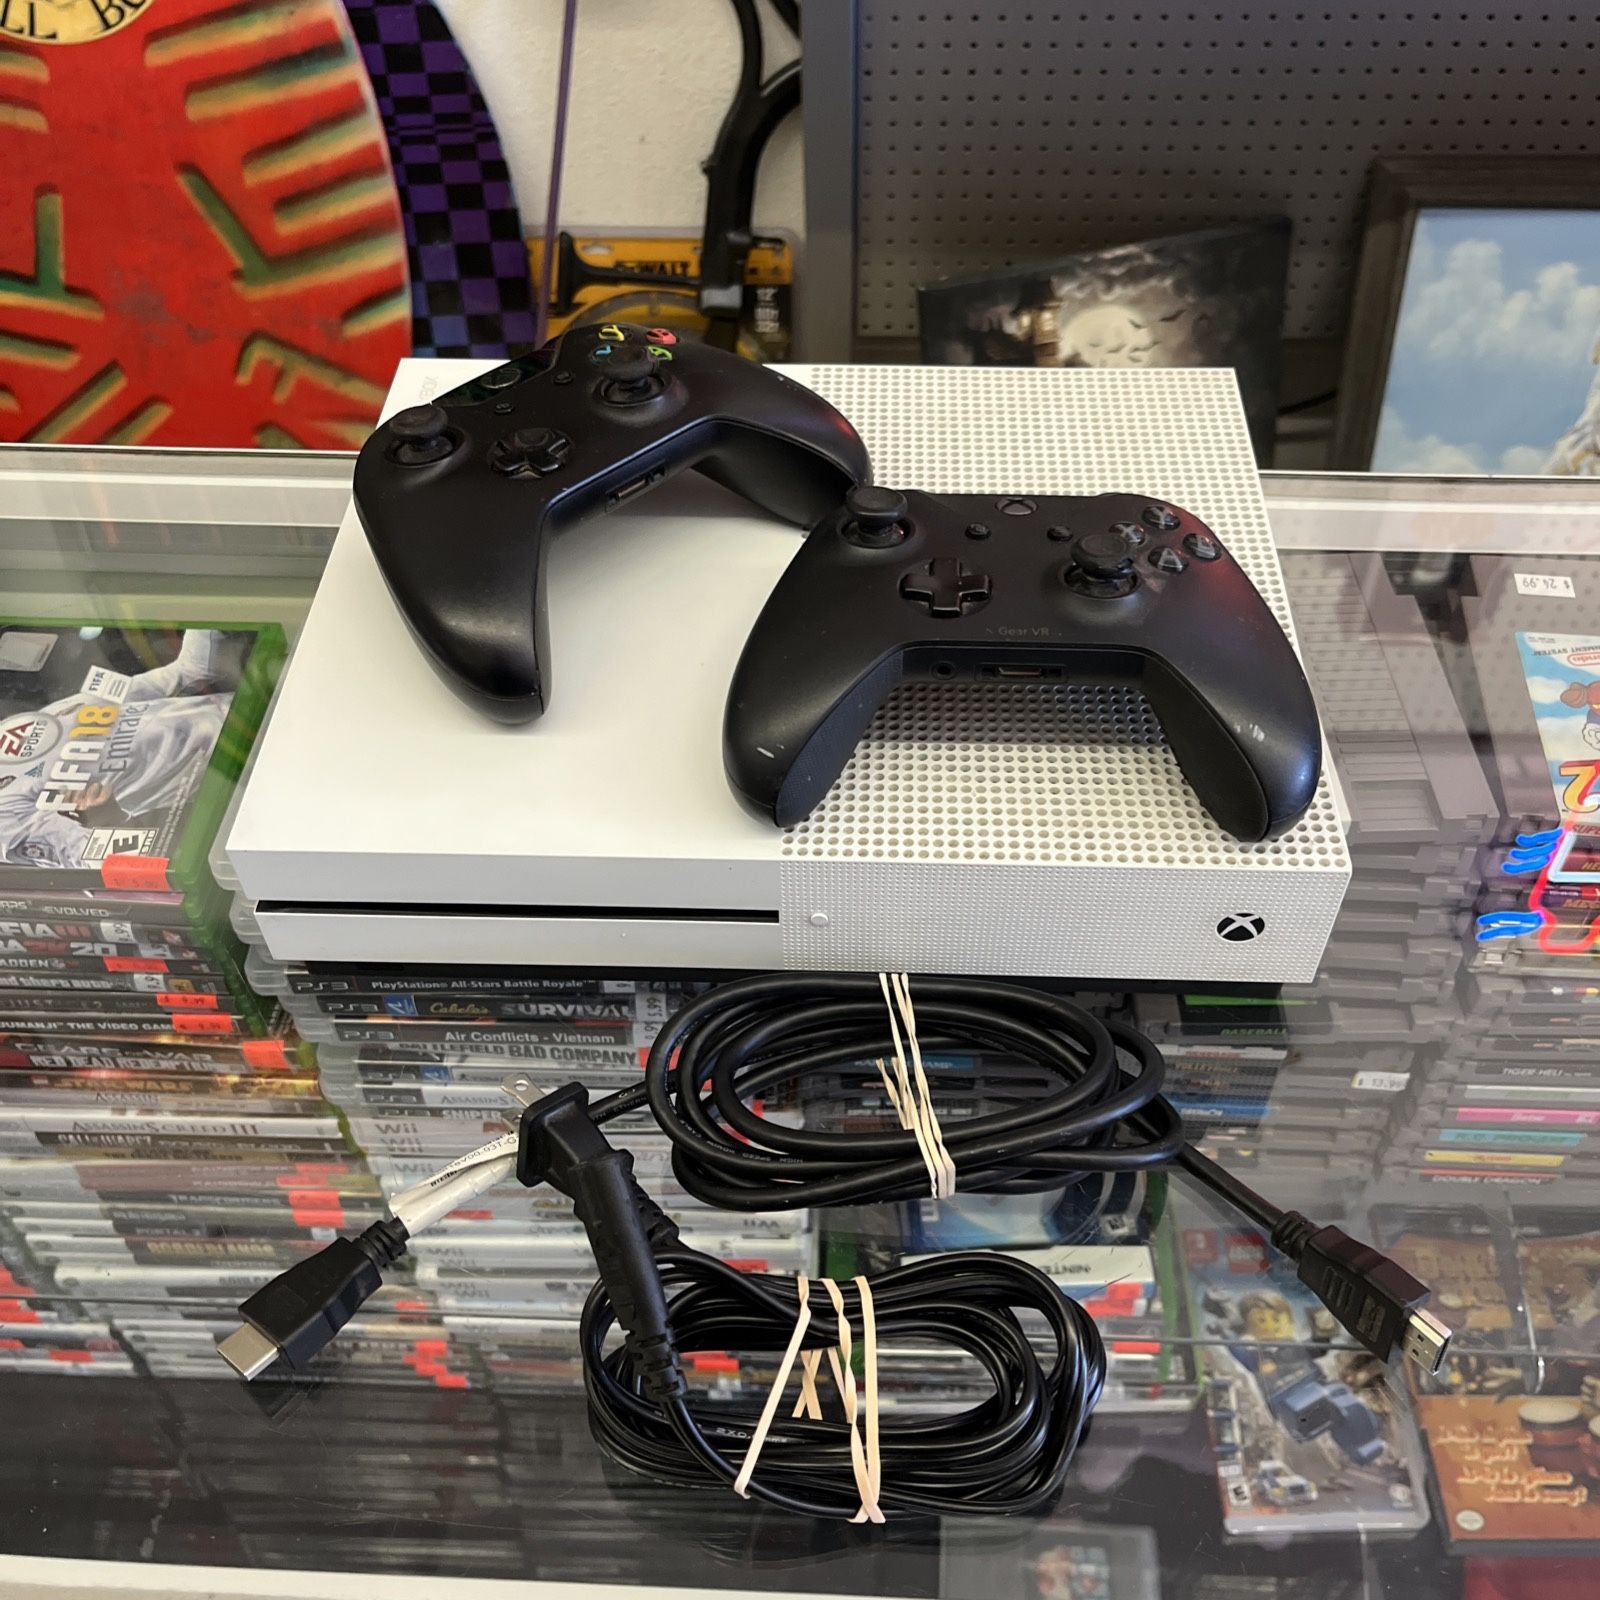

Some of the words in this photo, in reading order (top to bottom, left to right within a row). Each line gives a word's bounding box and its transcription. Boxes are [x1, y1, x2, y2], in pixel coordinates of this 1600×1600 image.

[1522, 577, 1558, 590] 24.99
[69, 704, 119, 739] 18
[20, 719, 48, 758] SPORTS
[36, 740, 106, 811] FIFA
[0, 921, 61, 940] FIA
[297, 981, 349, 991] PS3
[451, 980, 501, 990] All-Stars
[504, 979, 541, 989] Battle
[327, 1002, 379, 1013] PS3
[501, 1003, 635, 1018] SURVIVAL
[66, 1021, 96, 1031] THE
[97, 1021, 139, 1031] VIDEO
[141, 1023, 175, 1032] GAM
[343, 1030, 395, 1040] PS3
[445, 1031, 468, 1042] Air
[470, 1031, 539, 1044] Conflicts
[552, 1032, 615, 1044] Vietnam
[509, 1045, 547, 1060] BAD
[550, 1046, 637, 1065] COMPANY
[441, 1109, 500, 1121] SNIPER
[375, 1122, 419, 1135] Wii
